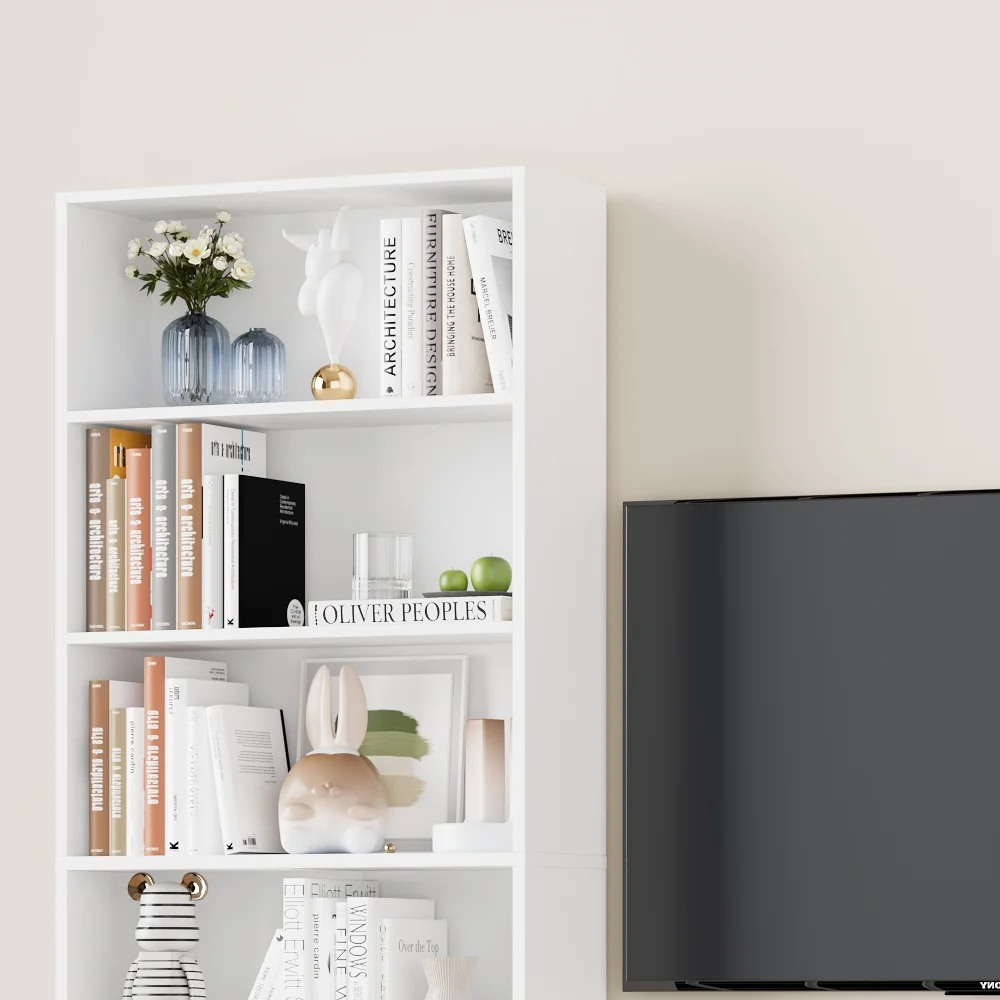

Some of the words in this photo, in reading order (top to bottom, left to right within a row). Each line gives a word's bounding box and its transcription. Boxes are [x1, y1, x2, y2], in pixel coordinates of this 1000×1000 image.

[497, 228, 512, 245] BRE
[426, 213, 436, 322] FURNITURE
[447, 255, 455, 276] HOME
[384, 237, 396, 376] ARCHITECTURE
[447, 278, 455, 303] HOUSE
[480, 277, 491, 309] MARCEL
[447, 305, 455, 319] THE
[485, 309, 497, 341] BREUER
[447, 321, 455, 357] BRINGING
[426, 327, 436, 396] DESIGN
[89, 482, 103, 503] arts
[155, 479, 169, 500] arts
[181, 478, 195, 499] arts
[130, 497, 144, 516] arts
[89, 520, 104, 581] architecture
[130, 529, 145, 585] architecture
[155, 516, 170, 578] architecture
[181, 515, 196, 577] architecture
[322, 603, 395, 624] OLIVER
[401, 600, 487, 622] PEOPLES
[284, 884, 304, 932] Elliott
[312, 914, 320, 944] pierre
[349, 903, 367, 978] WINDOWS
[336, 928, 347, 974] FINE
[399, 939, 413, 952] Over
[415, 939, 425, 952] the
[426, 939, 440, 956] Top
[284, 940, 304, 990] Erwitt
